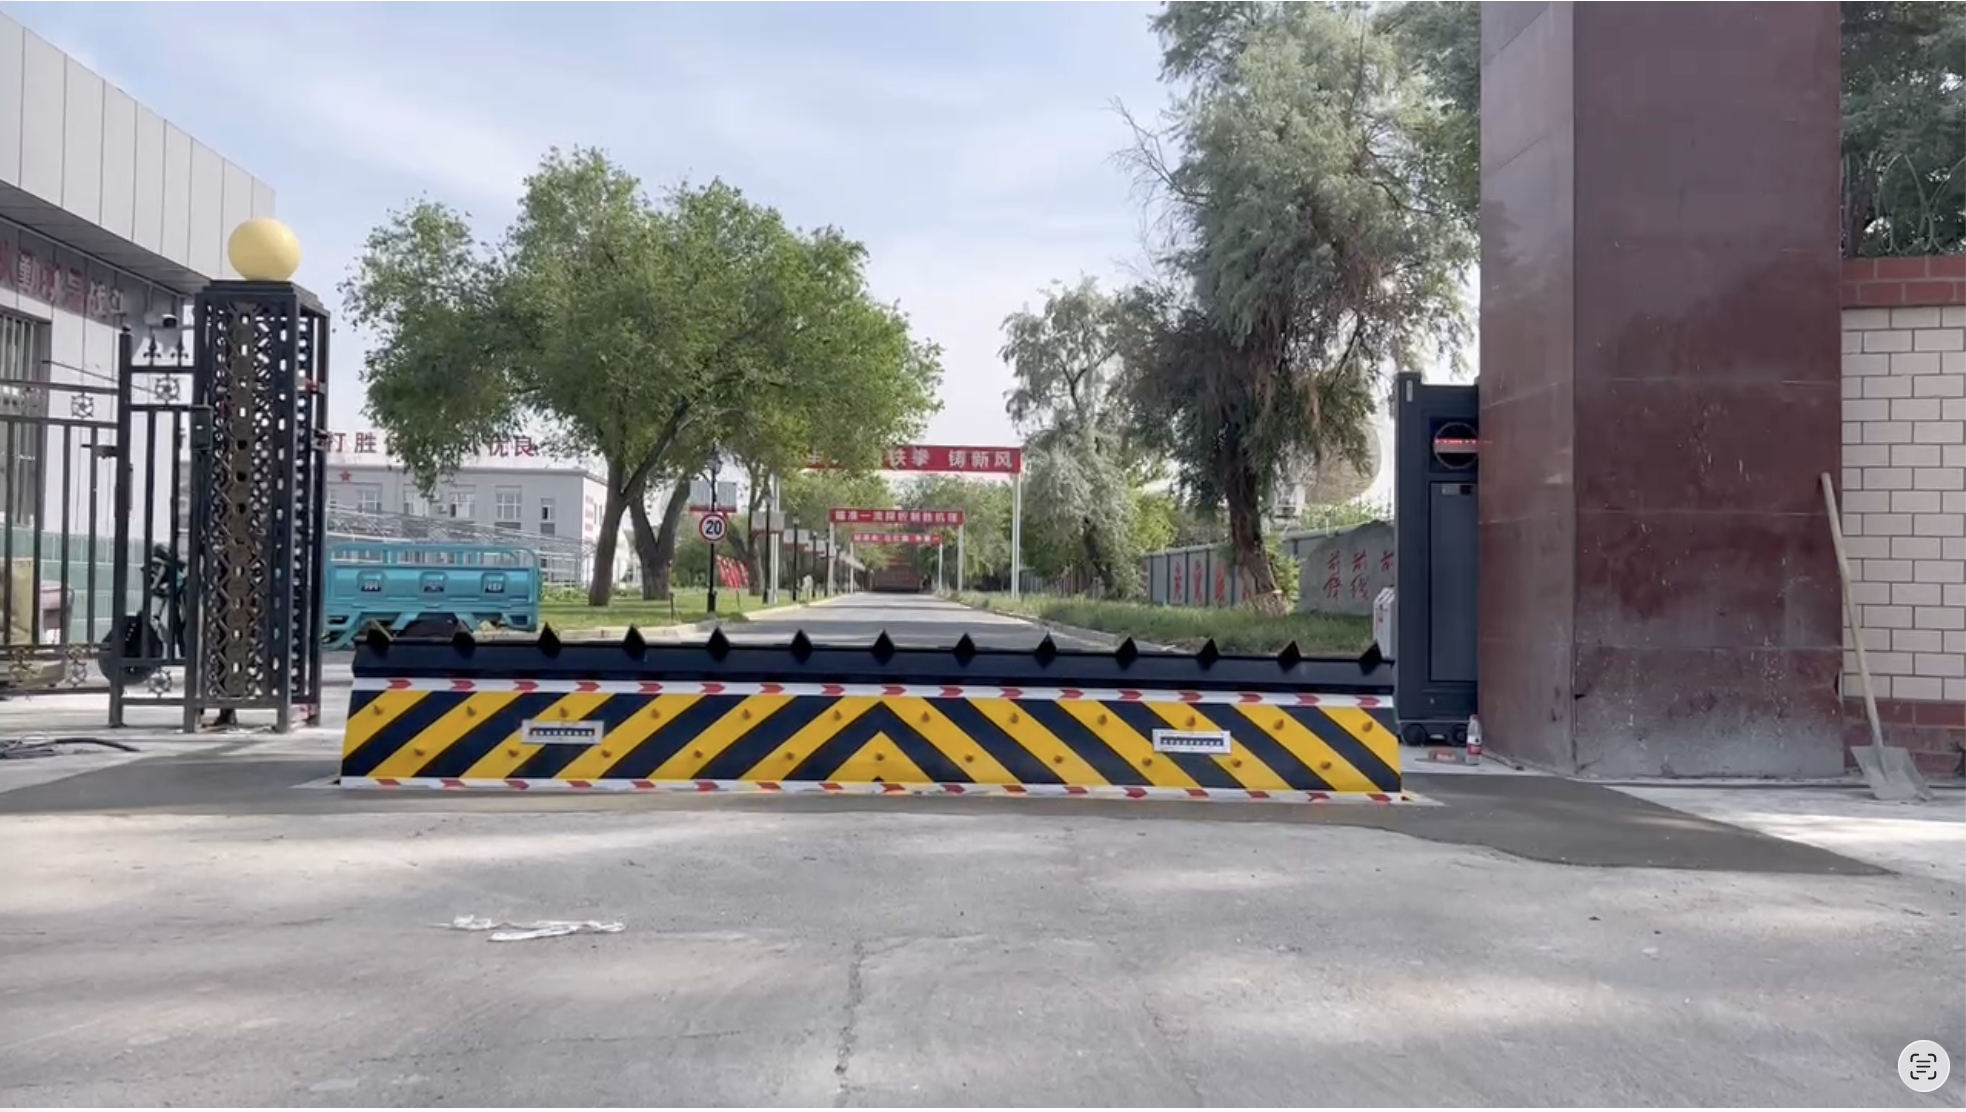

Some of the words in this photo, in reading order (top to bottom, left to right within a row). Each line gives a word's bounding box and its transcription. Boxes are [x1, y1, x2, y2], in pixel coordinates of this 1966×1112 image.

[948, 450, 1013, 469] 铸新风
[705, 520, 722, 535] 20
